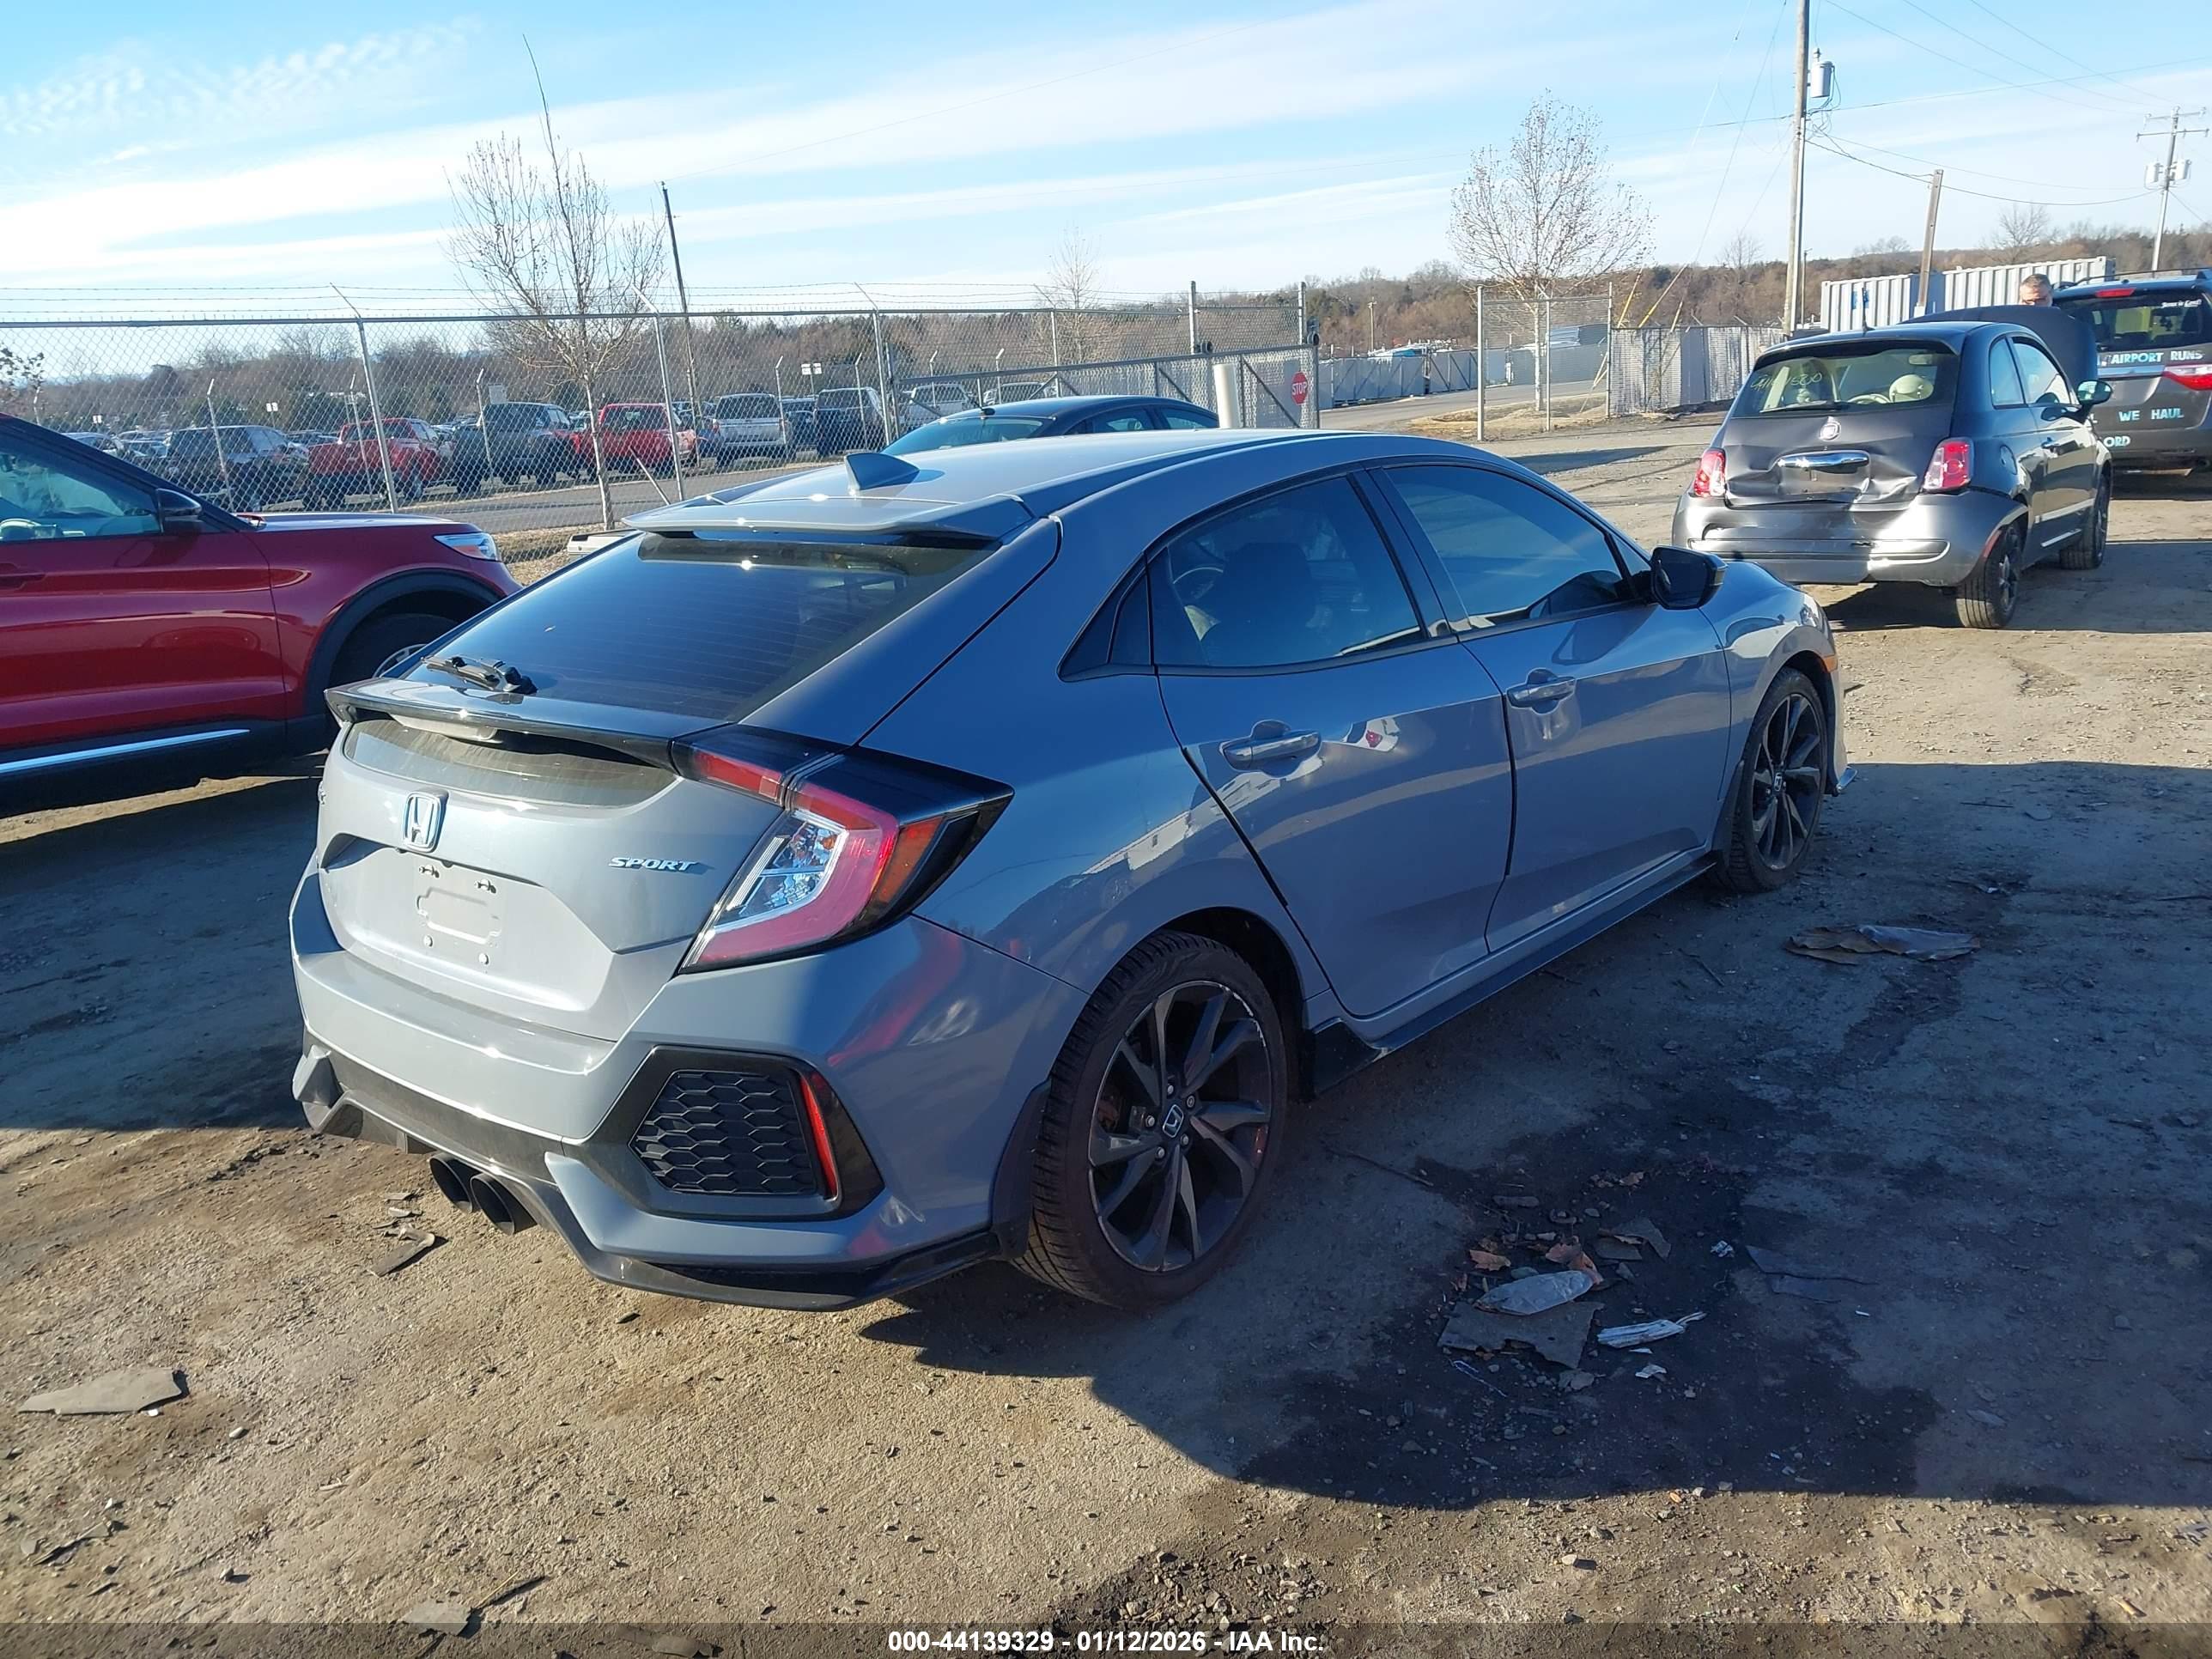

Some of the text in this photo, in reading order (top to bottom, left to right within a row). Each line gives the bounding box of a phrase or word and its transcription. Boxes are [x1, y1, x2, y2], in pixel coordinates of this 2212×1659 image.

[2111, 353, 2164, 364] AIRPORT
[2171, 350, 2203, 361] RUNS
[1292, 381, 1308, 396] STOP
[2118, 408, 2185, 422] WE HAUL
[2103, 435, 2130, 447] ORD
[608, 857, 699, 872] SPORT
